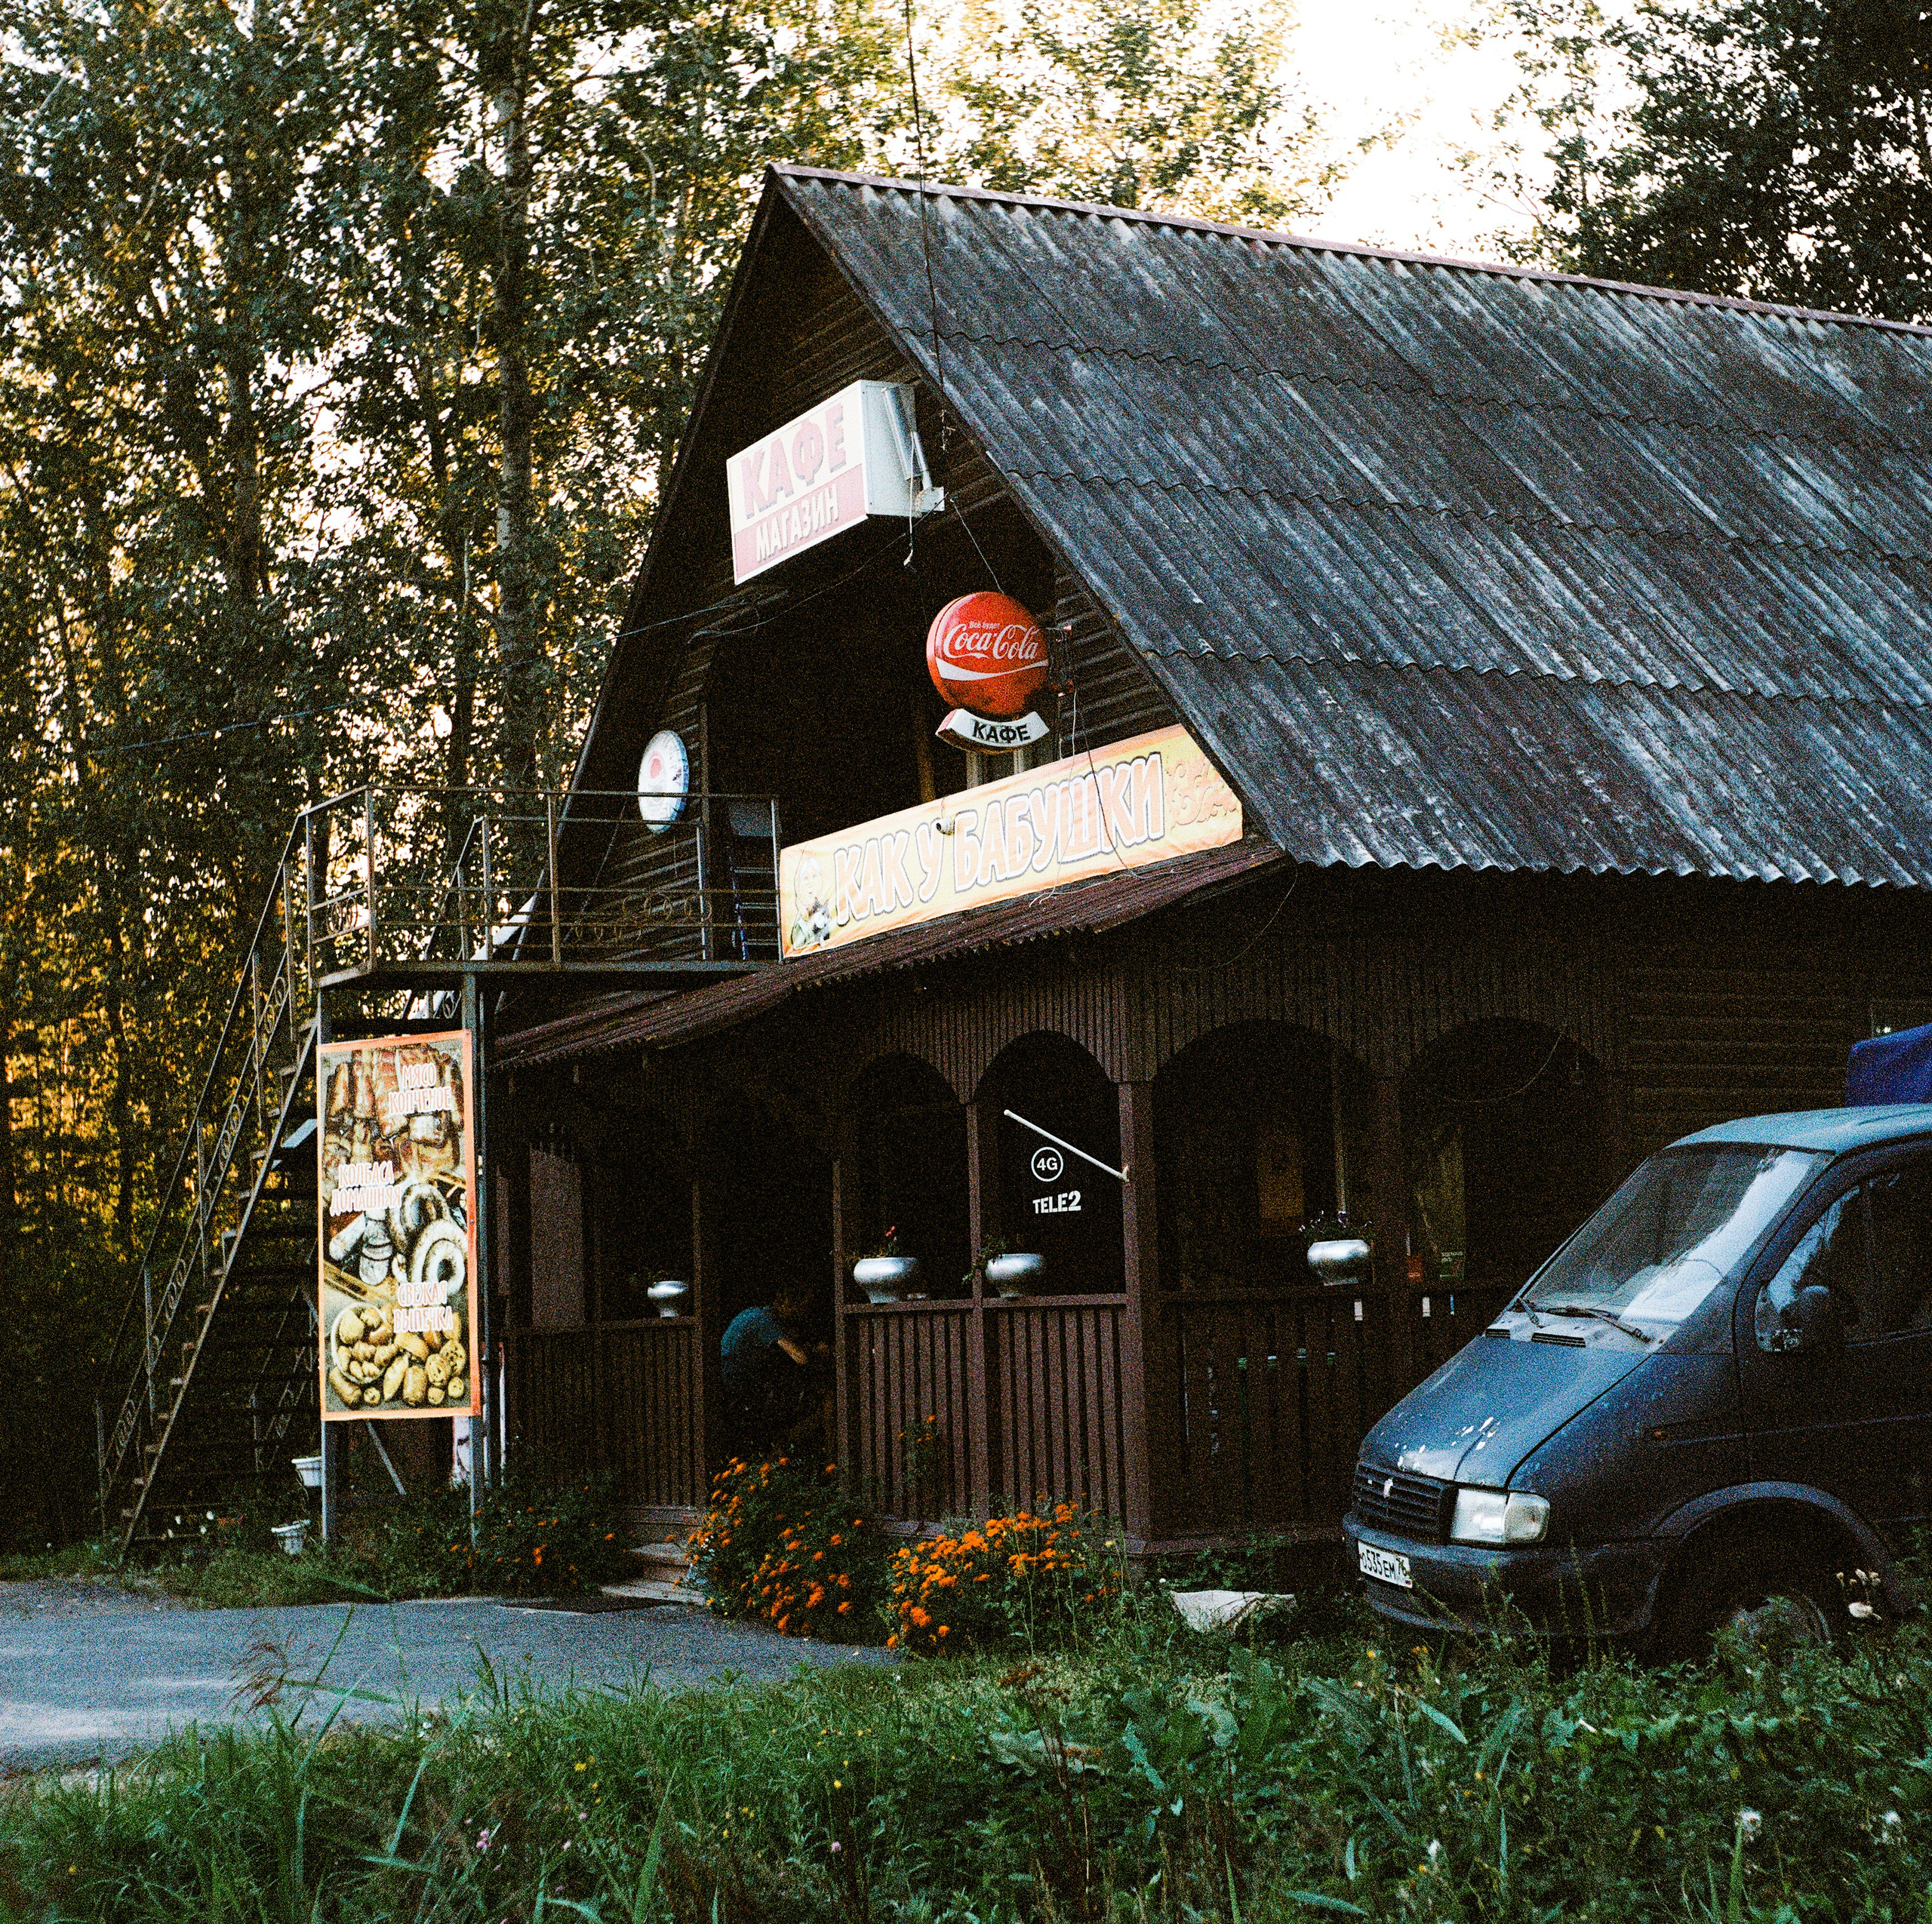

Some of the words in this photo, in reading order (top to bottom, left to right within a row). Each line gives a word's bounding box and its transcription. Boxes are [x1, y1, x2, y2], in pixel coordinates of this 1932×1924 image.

[740, 403, 847, 520] КАФЕ
[755, 484, 839, 563] МАГАЗИН
[943, 622, 1041, 660] Coca-Cola
[971, 719, 1031, 742] КАФЕ
[833, 829, 914, 927] КАК
[915, 817, 944, 903] У
[953, 751, 1165, 894] БАБУШКИ
[401, 1062, 438, 1088] МЯСО
[388, 1086, 452, 1114] КОПЧЕНОЕ
[338, 1161, 395, 1188] КОЛБАСА
[1036, 1157, 1058, 1170] 4G
[330, 1185, 402, 1216] ДОМАШНЯЯ
[1032, 1190, 1081, 1214] TELE2
[397, 1280, 448, 1307] СВЕЖАЯ
[393, 1306, 454, 1333] ВЫПЕЧКА
